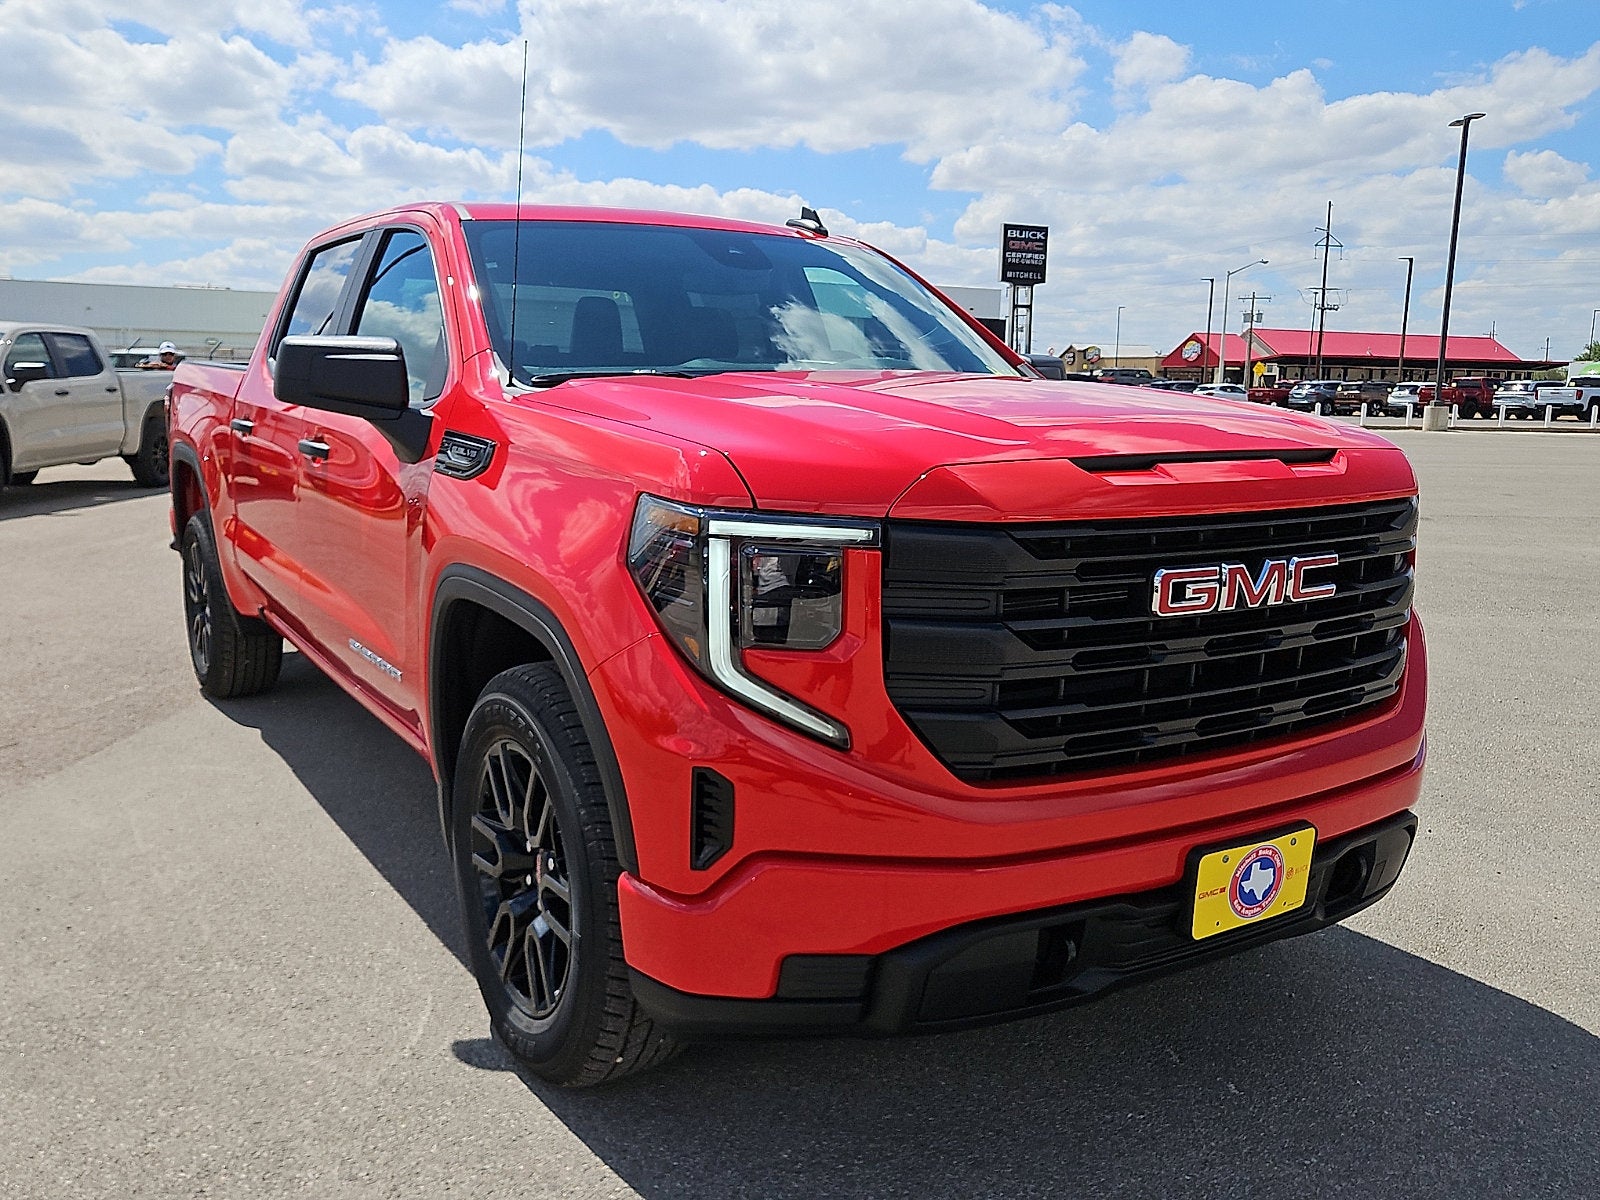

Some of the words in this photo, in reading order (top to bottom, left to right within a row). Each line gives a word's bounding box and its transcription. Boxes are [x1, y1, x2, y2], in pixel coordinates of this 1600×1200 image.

[1007, 229, 1045, 239] BUICK
[1008, 240, 1044, 251] GMC
[1005, 252, 1045, 260] CERTIFIED
[1006, 271, 1041, 279] MITCHELL
[1151, 552, 1339, 617] GMC
[1198, 888, 1219, 900] GMC
